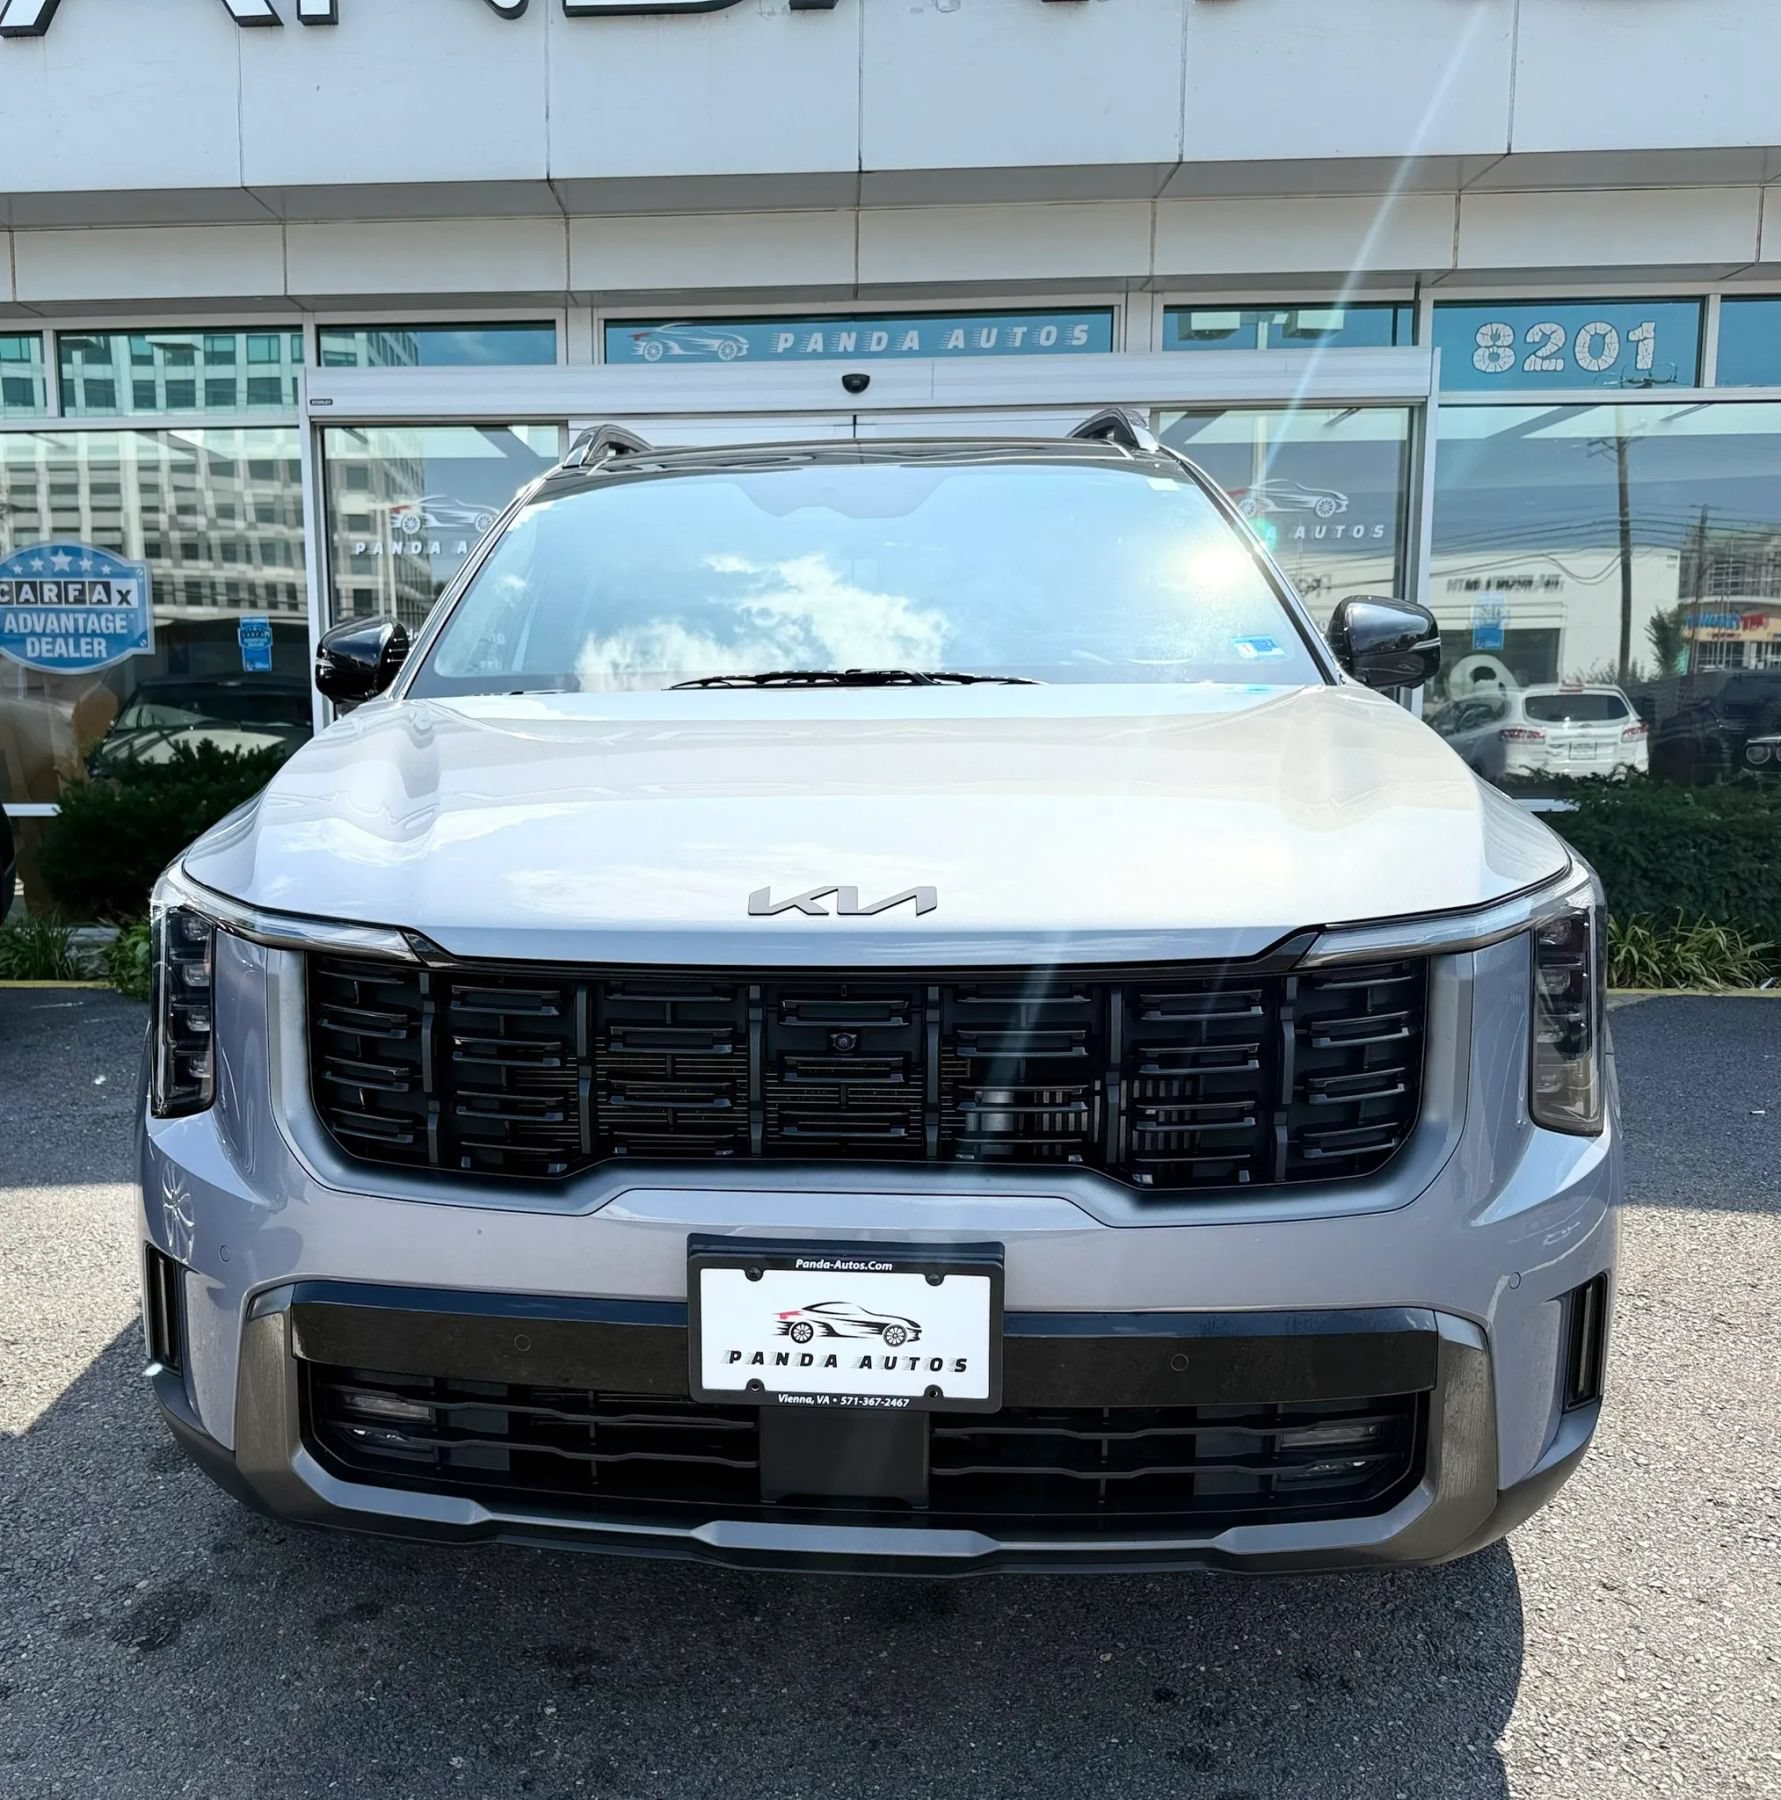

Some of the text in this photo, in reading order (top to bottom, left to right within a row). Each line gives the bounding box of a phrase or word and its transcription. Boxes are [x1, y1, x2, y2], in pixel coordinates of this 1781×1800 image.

[772, 324, 1089, 353] PANDA AUTOS
[1472, 320, 1657, 374] 8201
[1293, 524, 1385, 540] AUTOS
[353, 540, 441, 556] PANDA
[0, 582, 133, 607] CARFAX
[3, 612, 128, 635] ADVANTAGE
[26, 637, 108, 659] DEALER
[795, 1258, 893, 1271] Panda-Autos.Com
[724, 1349, 968, 1374] PANDA AUTOS
[777, 1393, 910, 1408] Vienna, VA 571-367-2467
